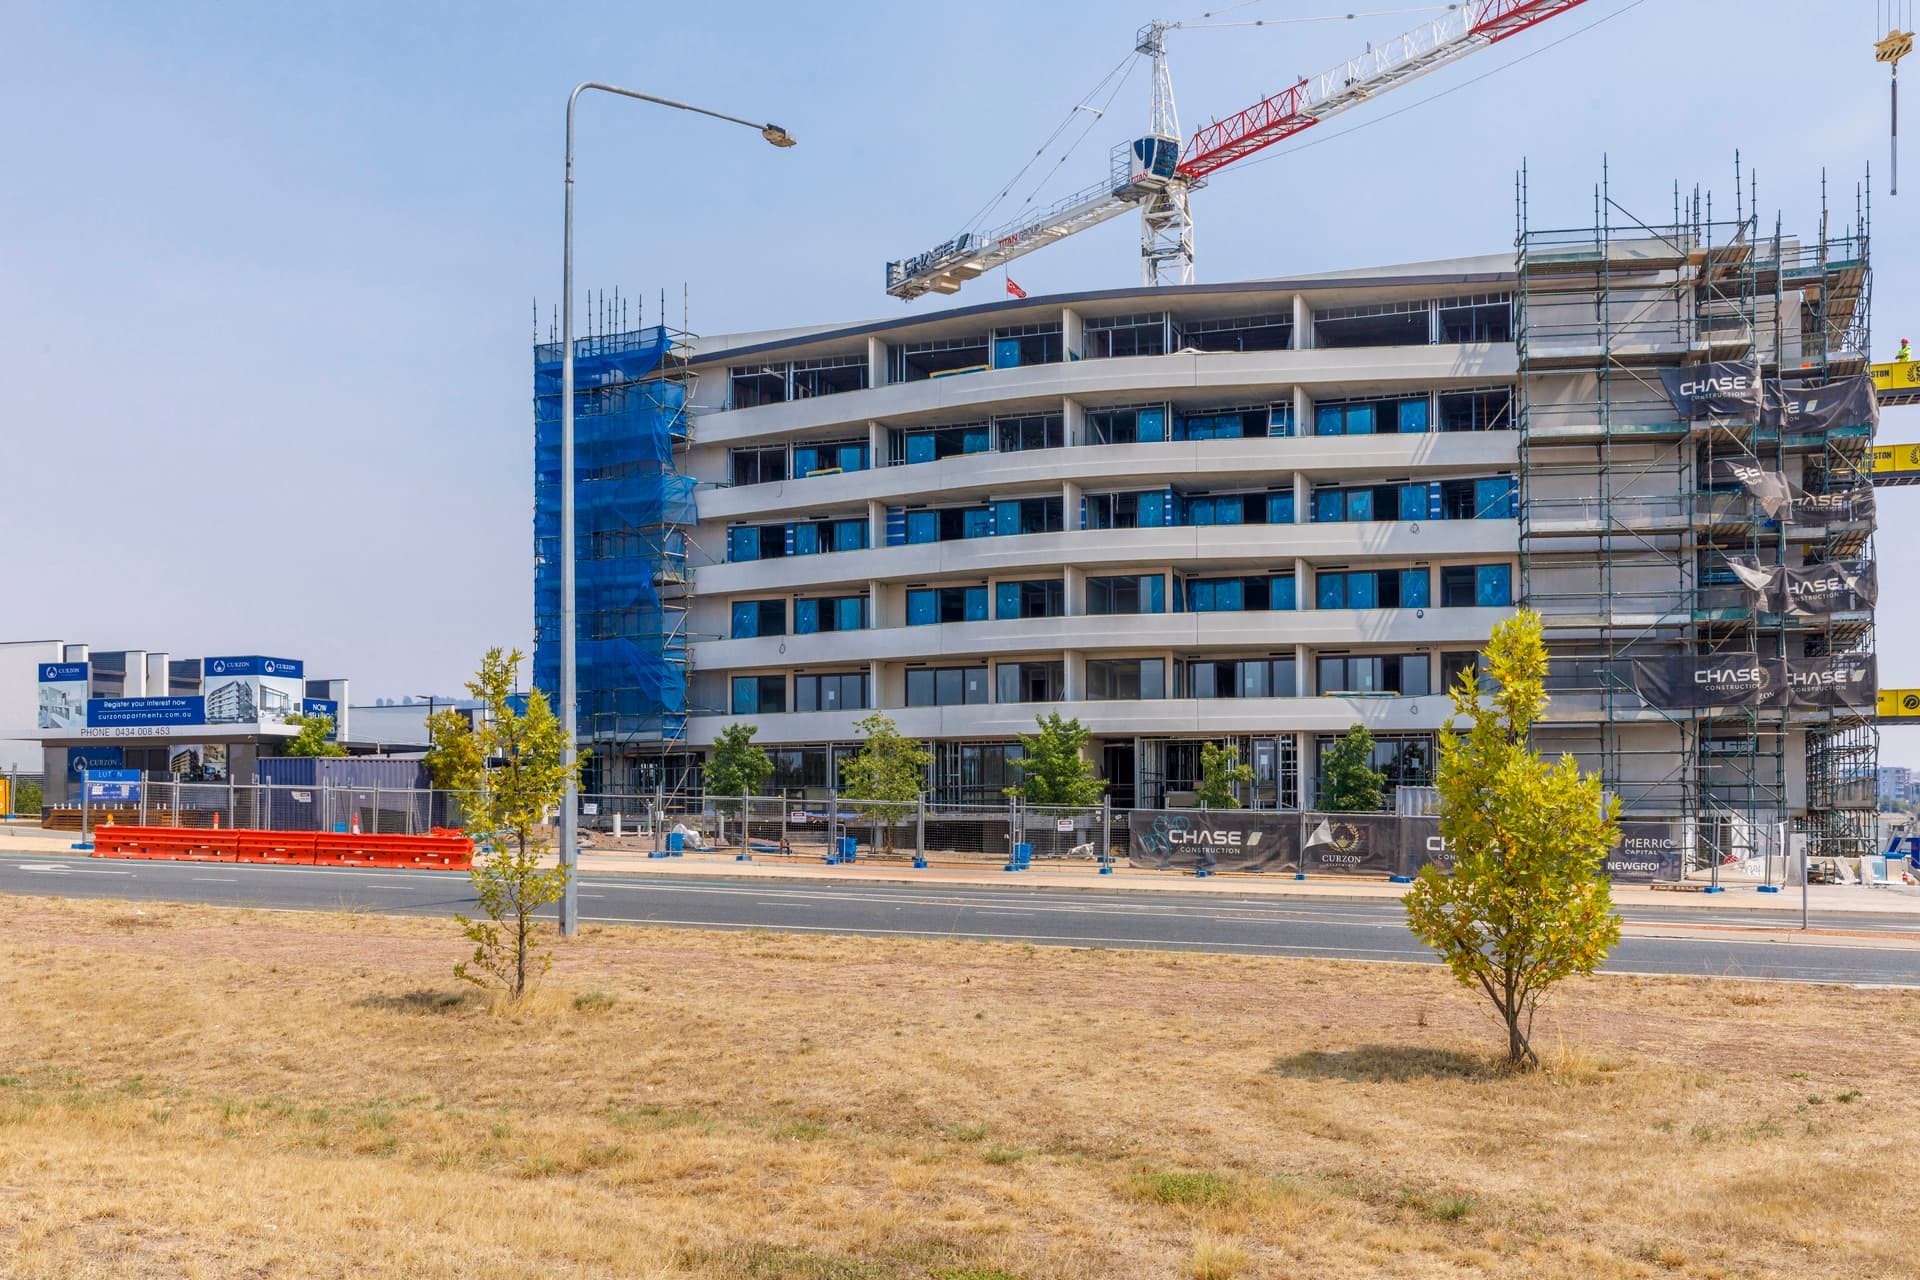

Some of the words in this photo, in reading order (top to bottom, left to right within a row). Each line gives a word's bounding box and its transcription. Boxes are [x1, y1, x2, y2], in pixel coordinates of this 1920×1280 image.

[998, 233, 1018, 249] TITAN
[1018, 223, 1041, 240] GROUP
[903, 239, 954, 275] CHASE
[1679, 376, 1747, 396] CHASE
[1691, 391, 1746, 401] CONSTRUCTION
[1791, 495, 1844, 506] ASE
[1787, 577, 1840, 594] HASE
[276, 663, 296, 671] CURZON
[1694, 668, 1760, 684] CHASE
[1791, 685, 1847, 693] CONSTRUCTION
[103, 701, 130, 709] Register
[312, 703, 328, 711] NOW
[80, 728, 110, 737] PHONE
[115, 727, 135, 736] 0434
[137, 727, 153, 736] 008
[155, 727, 170, 736] 453
[98, 770, 123, 778] LUTON
[1168, 829, 1242, 846] CHASE
[1624, 838, 1671, 849] MERRIC
[1180, 846, 1240, 855] CONSTRUCTION
[1321, 854, 1361, 864] CURZON
